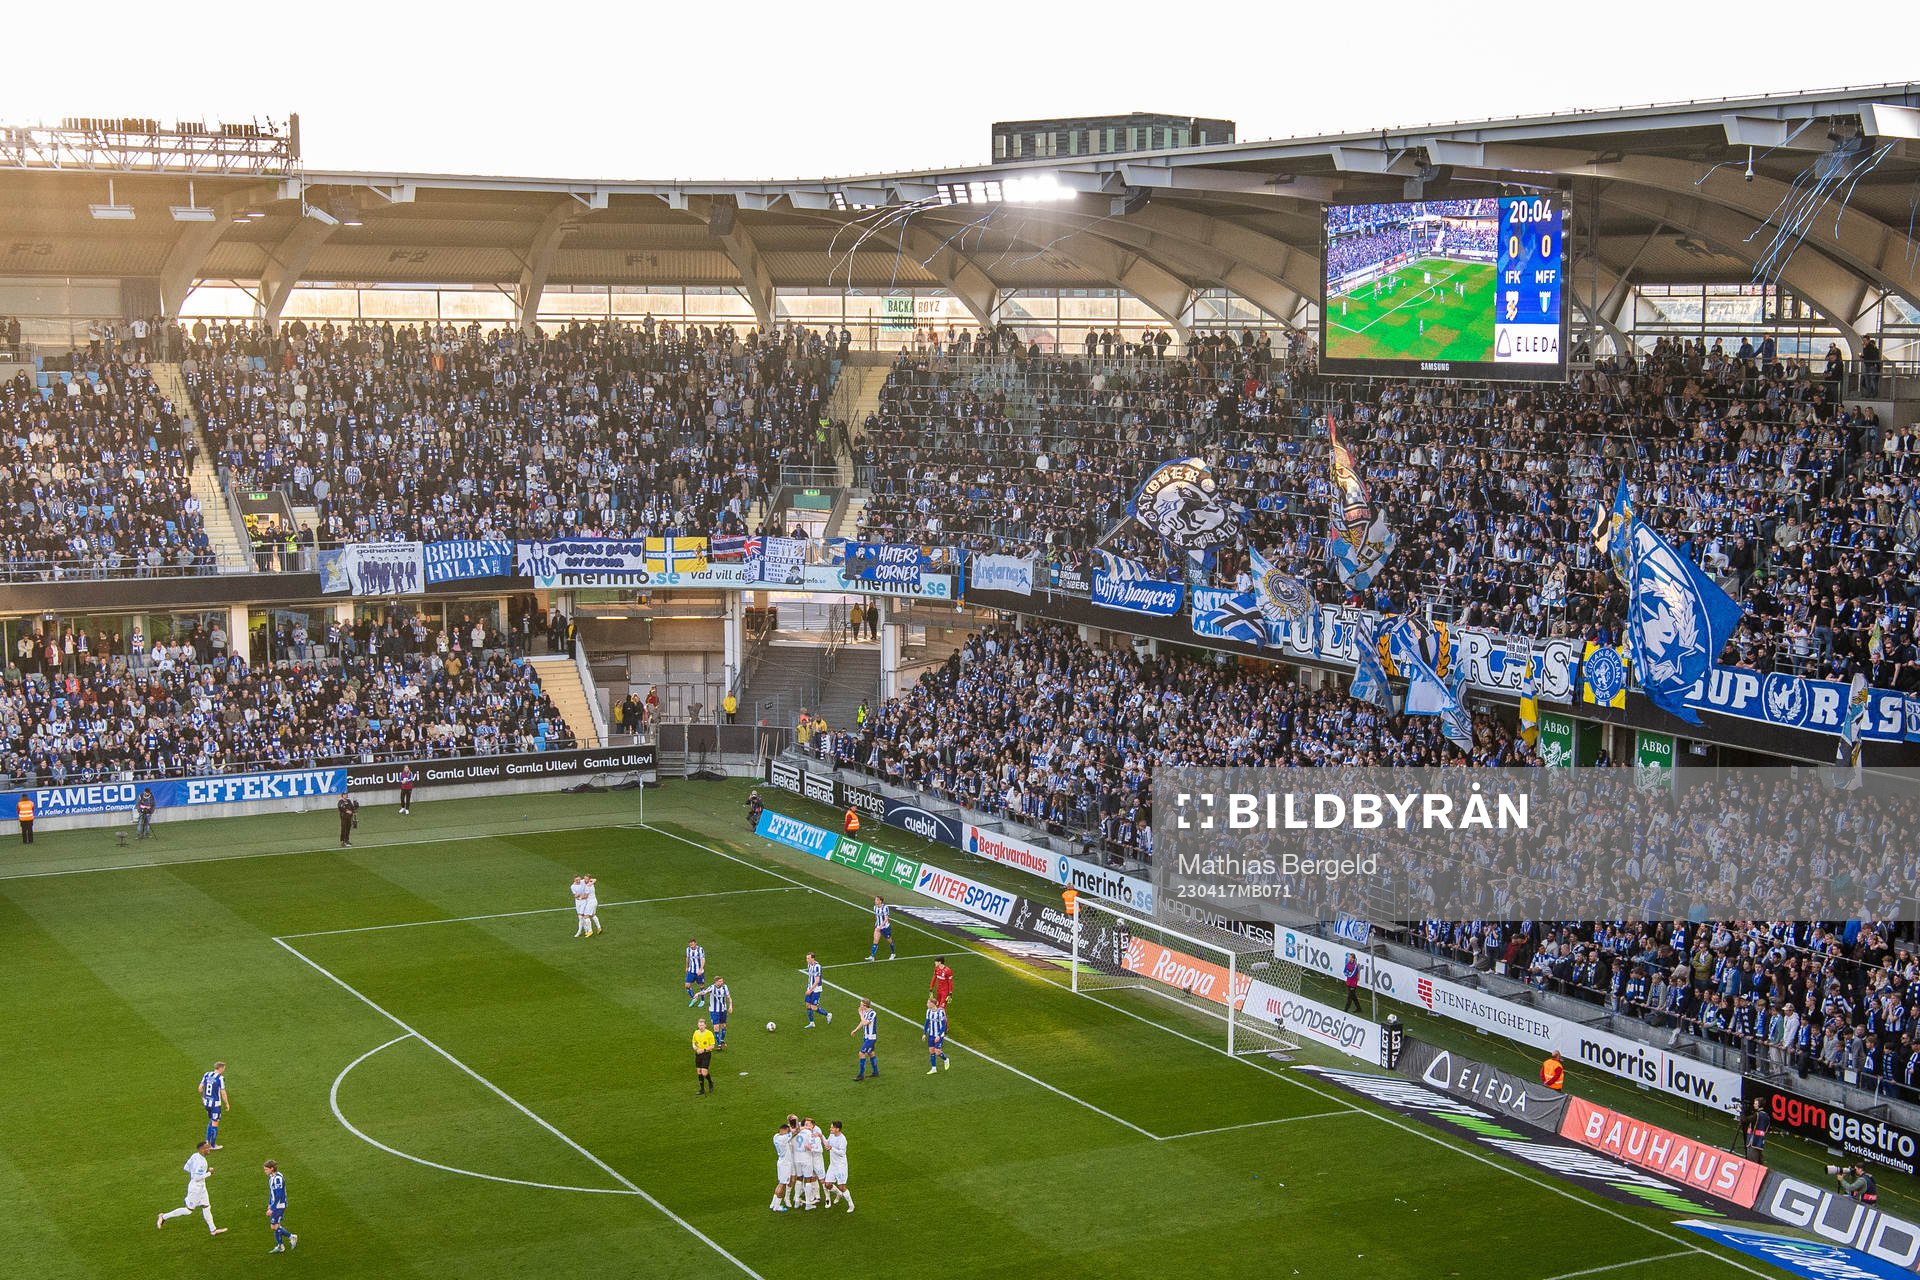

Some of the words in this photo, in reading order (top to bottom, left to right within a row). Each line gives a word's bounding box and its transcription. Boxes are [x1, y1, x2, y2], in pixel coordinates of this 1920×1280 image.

[1509, 200, 1552, 224] 20:04
[1509, 236, 1518, 258] 0
[1541, 235, 1551, 257] 0
[1505, 271, 1521, 284] IFK
[1535, 270, 1555, 284] MFF
[918, 301, 940, 313] BOYZ
[1516, 336, 1558, 352] ELEDA
[1420, 362, 1449, 371] SAMSUNG
[425, 540, 512, 563] BEBBENS
[879, 545, 918, 564] HATERS
[691, 568, 713, 580] vad
[716, 569, 732, 580] vill
[876, 565, 918, 581] CORNER
[506, 762, 543, 774] Gamla
[545, 759, 577, 772] Ullevi
[583, 757, 620, 769] Gamla
[621, 753, 653, 766] Ullevi
[347, 775, 383, 787] Gamla
[386, 771, 420, 784] Ullvi
[426, 769, 464, 781] Gamla
[467, 765, 500, 778] Ullevi
[36, 784, 136, 808] FAMECO
[187, 770, 335, 804] EFFEKTIV
[71, 806, 104, 814] Kalmbach
[842, 784, 885, 814] Helanders
[767, 814, 827, 849] EFFEKTIV
[904, 816, 937, 839] cuebid
[841, 842, 857, 857] MCR
[867, 852, 884, 867] MCR
[978, 837, 1048, 874] Bergkvarabuss
[895, 863, 912, 877] MCR
[930, 873, 1010, 917] INTERSPORT
[1072, 868, 1154, 911] merinfo.se
[1152, 949, 1215, 996] Renova
[1434, 988, 1552, 1041] STENFASTIGHETER
[1381, 1028, 1389, 1069] SELECT
[1580, 1038, 1657, 1082] morris
[206, 1083, 212, 1096] 8
[1458, 1069, 1527, 1112] ELEDA
[1585, 1111, 1738, 1189] BAUHAUS
